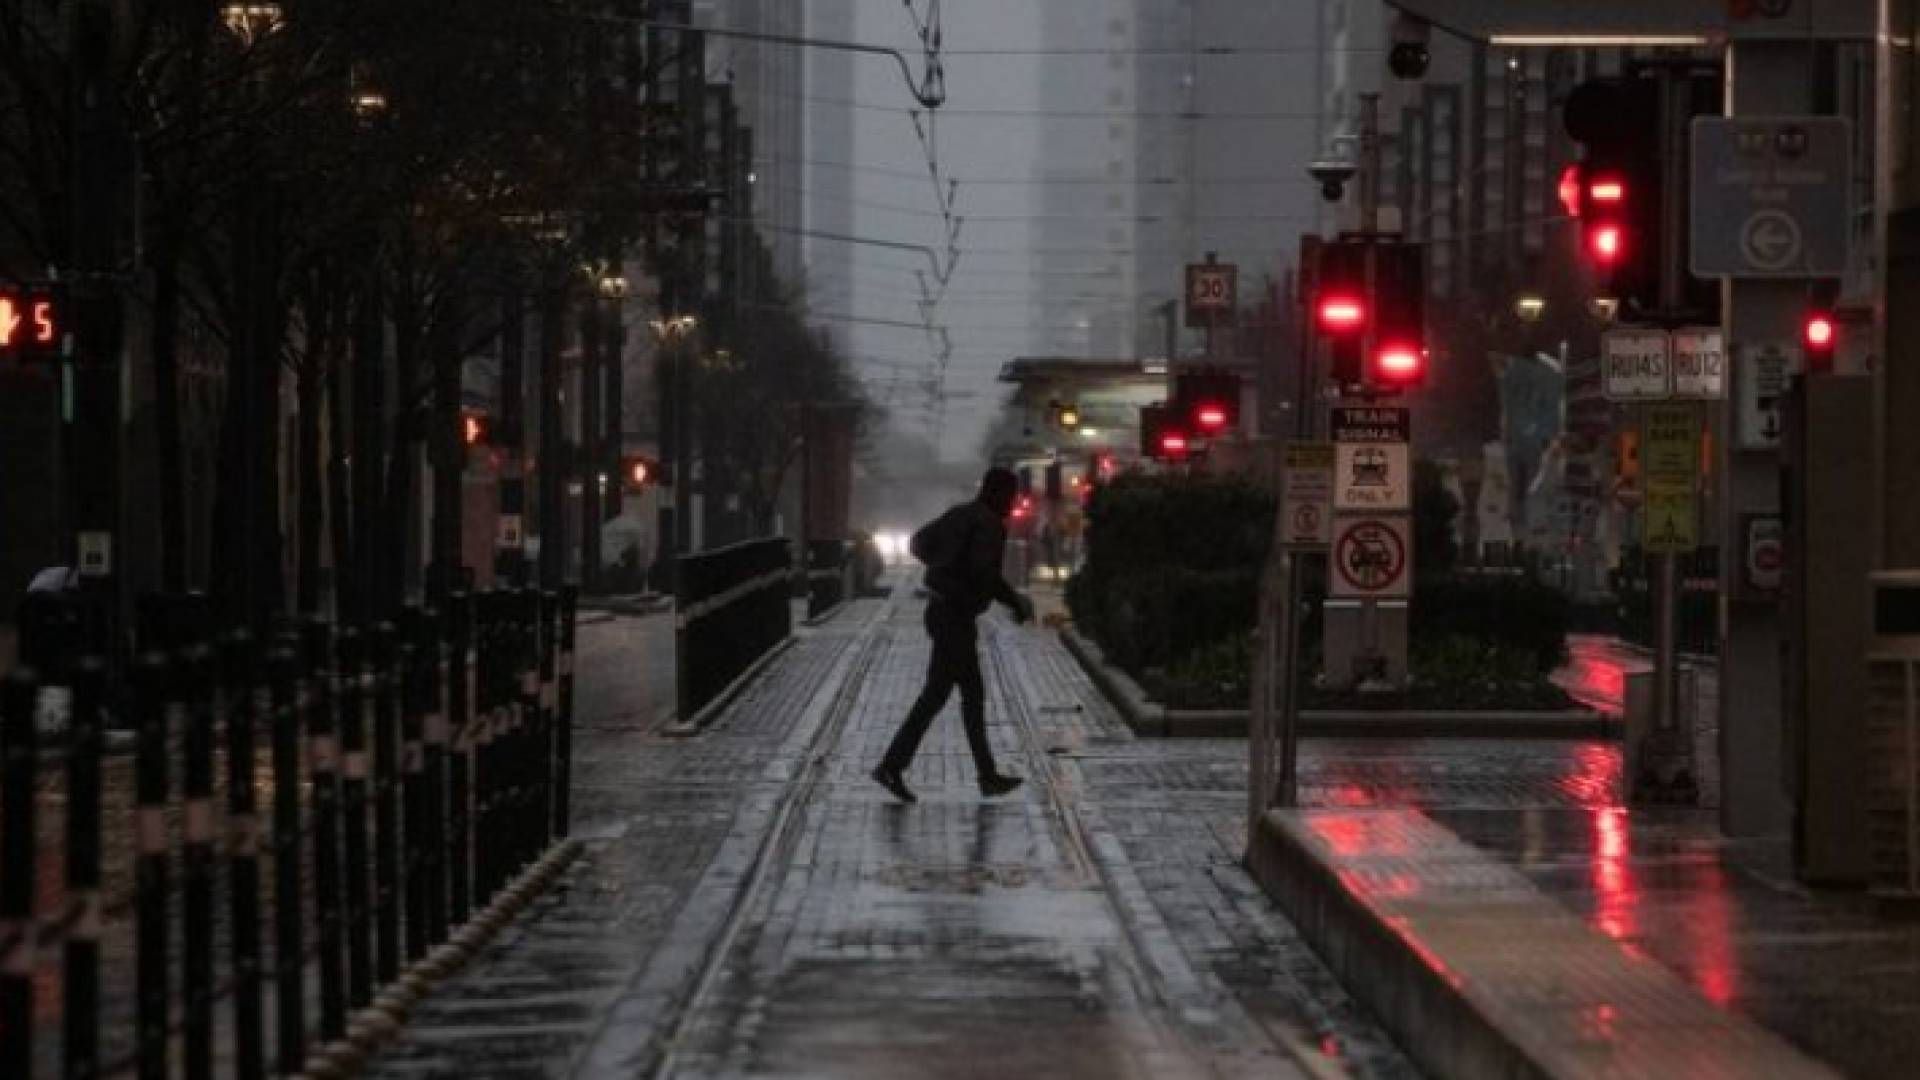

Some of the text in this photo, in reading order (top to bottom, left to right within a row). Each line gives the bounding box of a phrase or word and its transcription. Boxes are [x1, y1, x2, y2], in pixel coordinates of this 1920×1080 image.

[34, 301, 53, 341] 5
[1345, 409, 1399, 425] TRAIN
[1337, 427, 1402, 441] SIGNAL
[1345, 488, 1395, 503] ONLY
